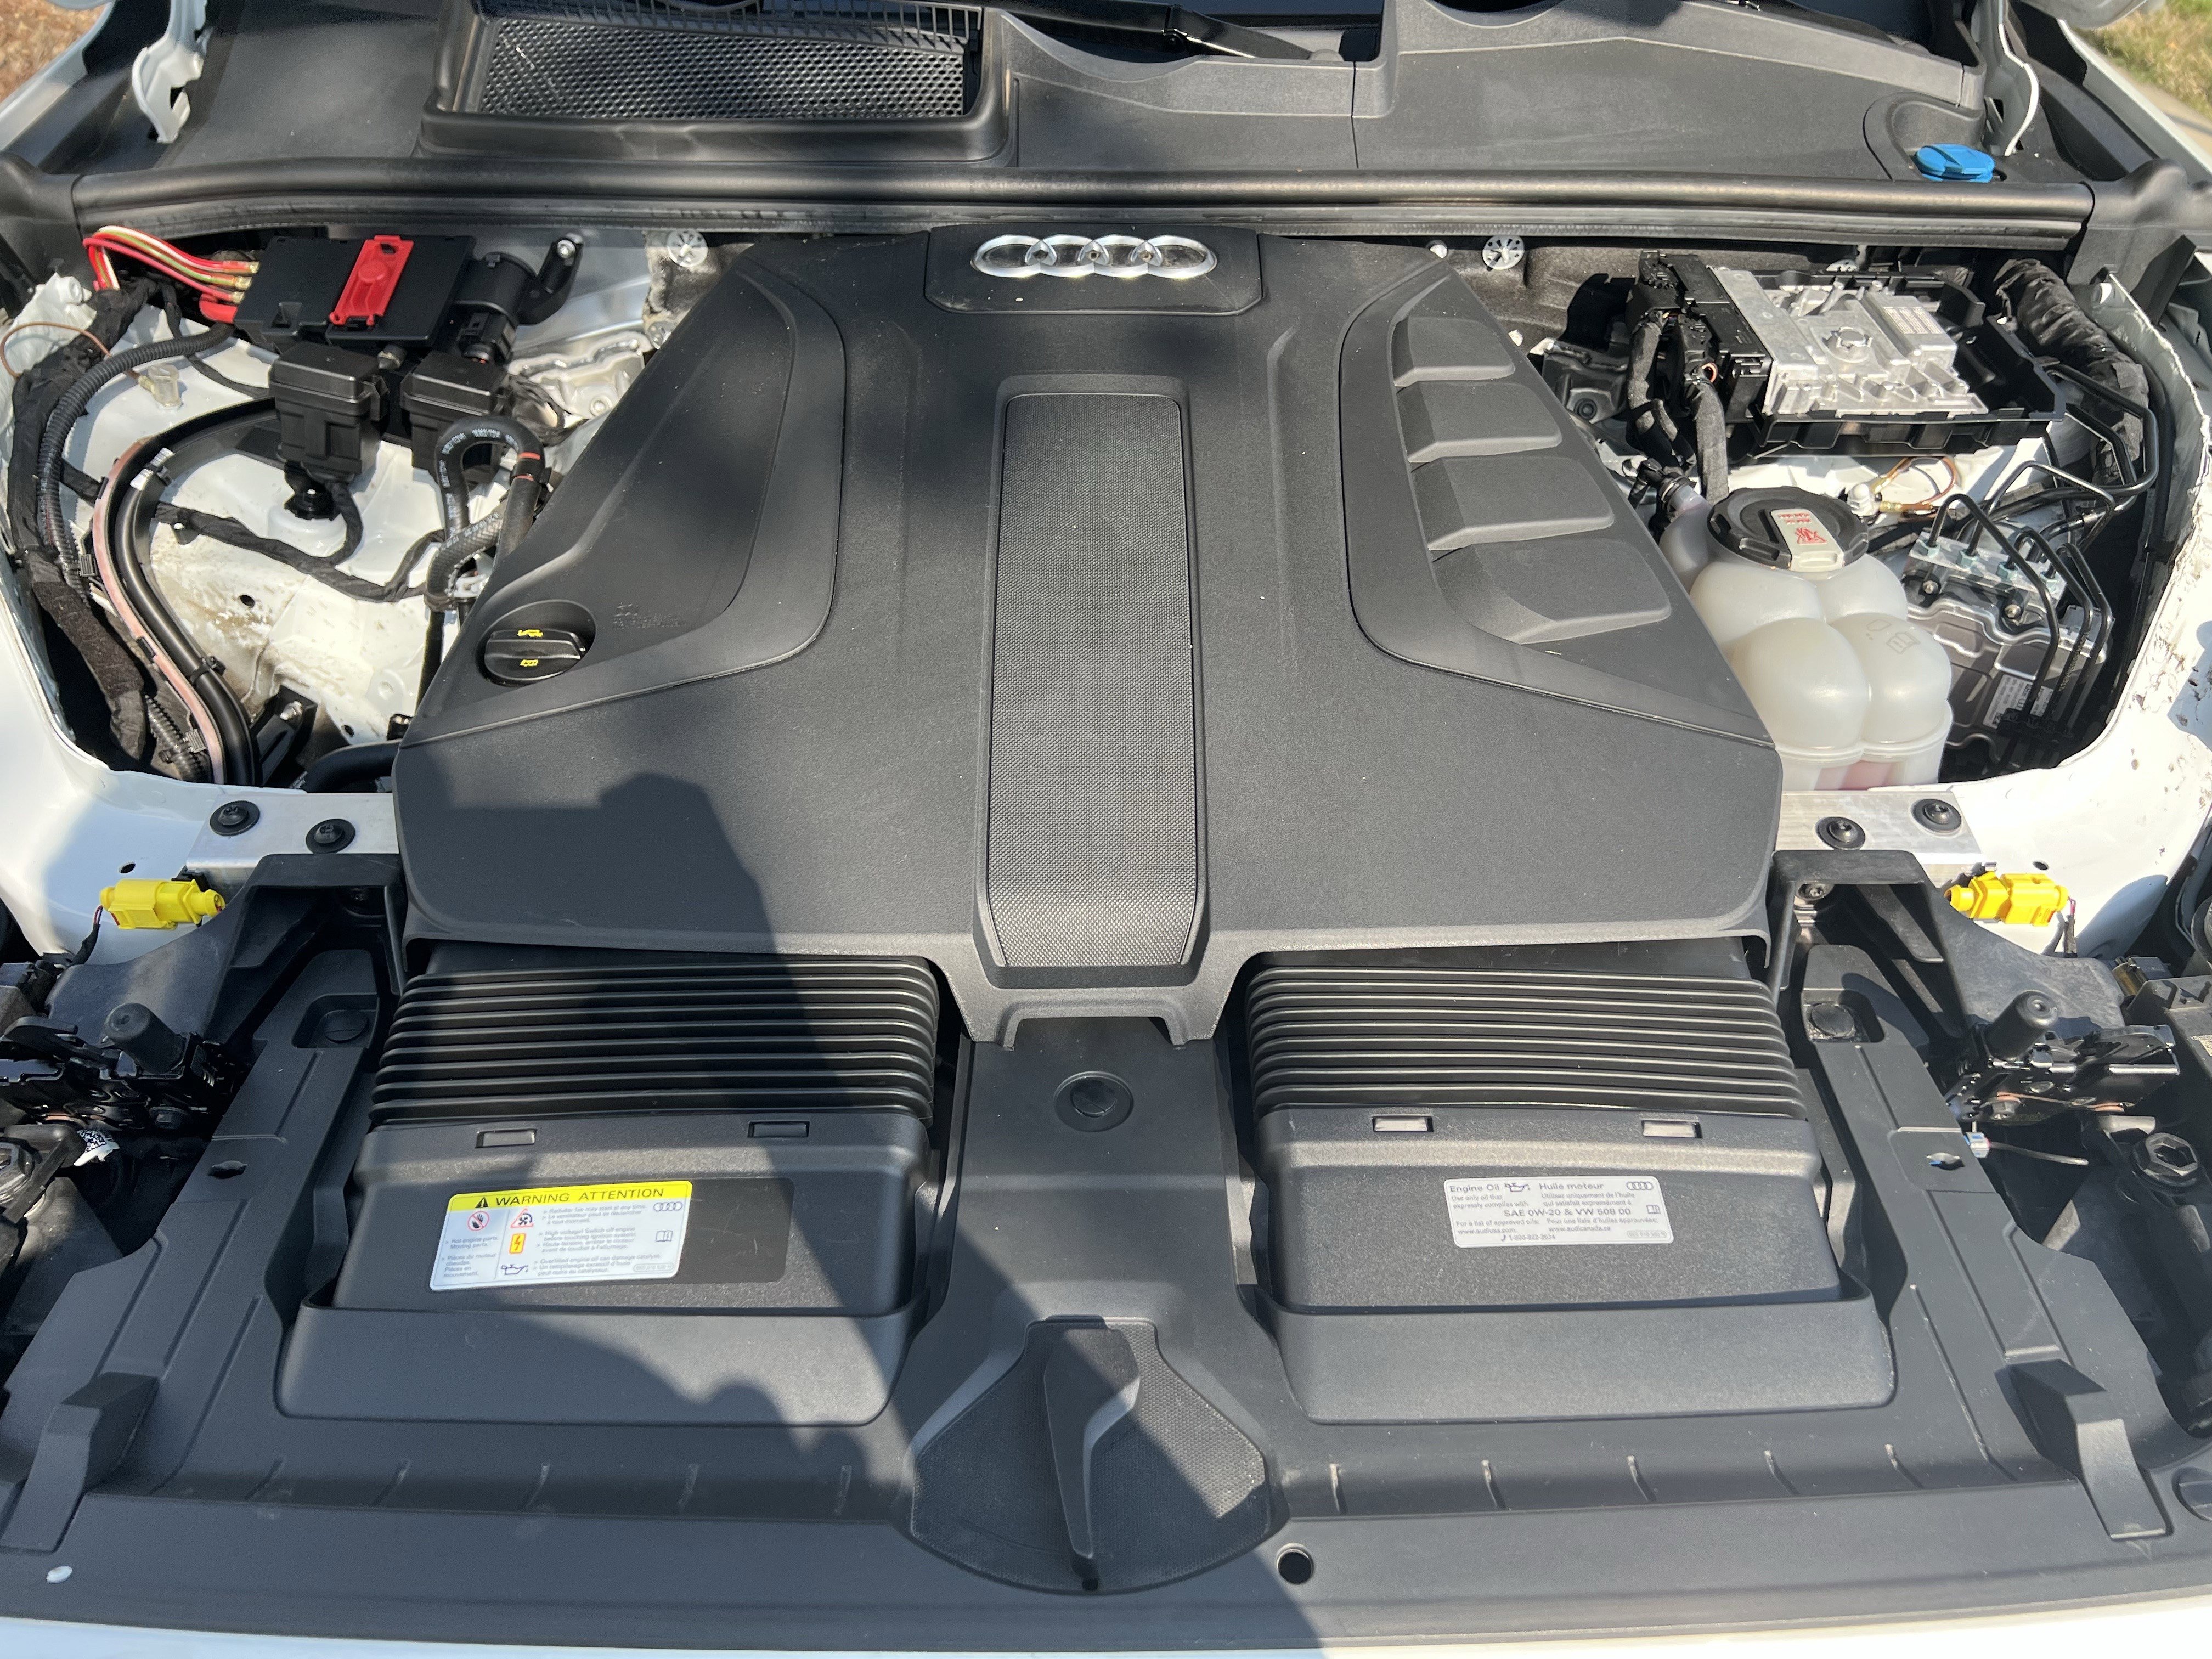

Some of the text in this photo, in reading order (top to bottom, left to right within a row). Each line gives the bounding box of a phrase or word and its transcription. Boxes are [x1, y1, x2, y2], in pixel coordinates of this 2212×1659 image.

[1450, 1184, 1483, 1193] Engine
[496, 1188, 664, 1206] WARNING ATTENTION
